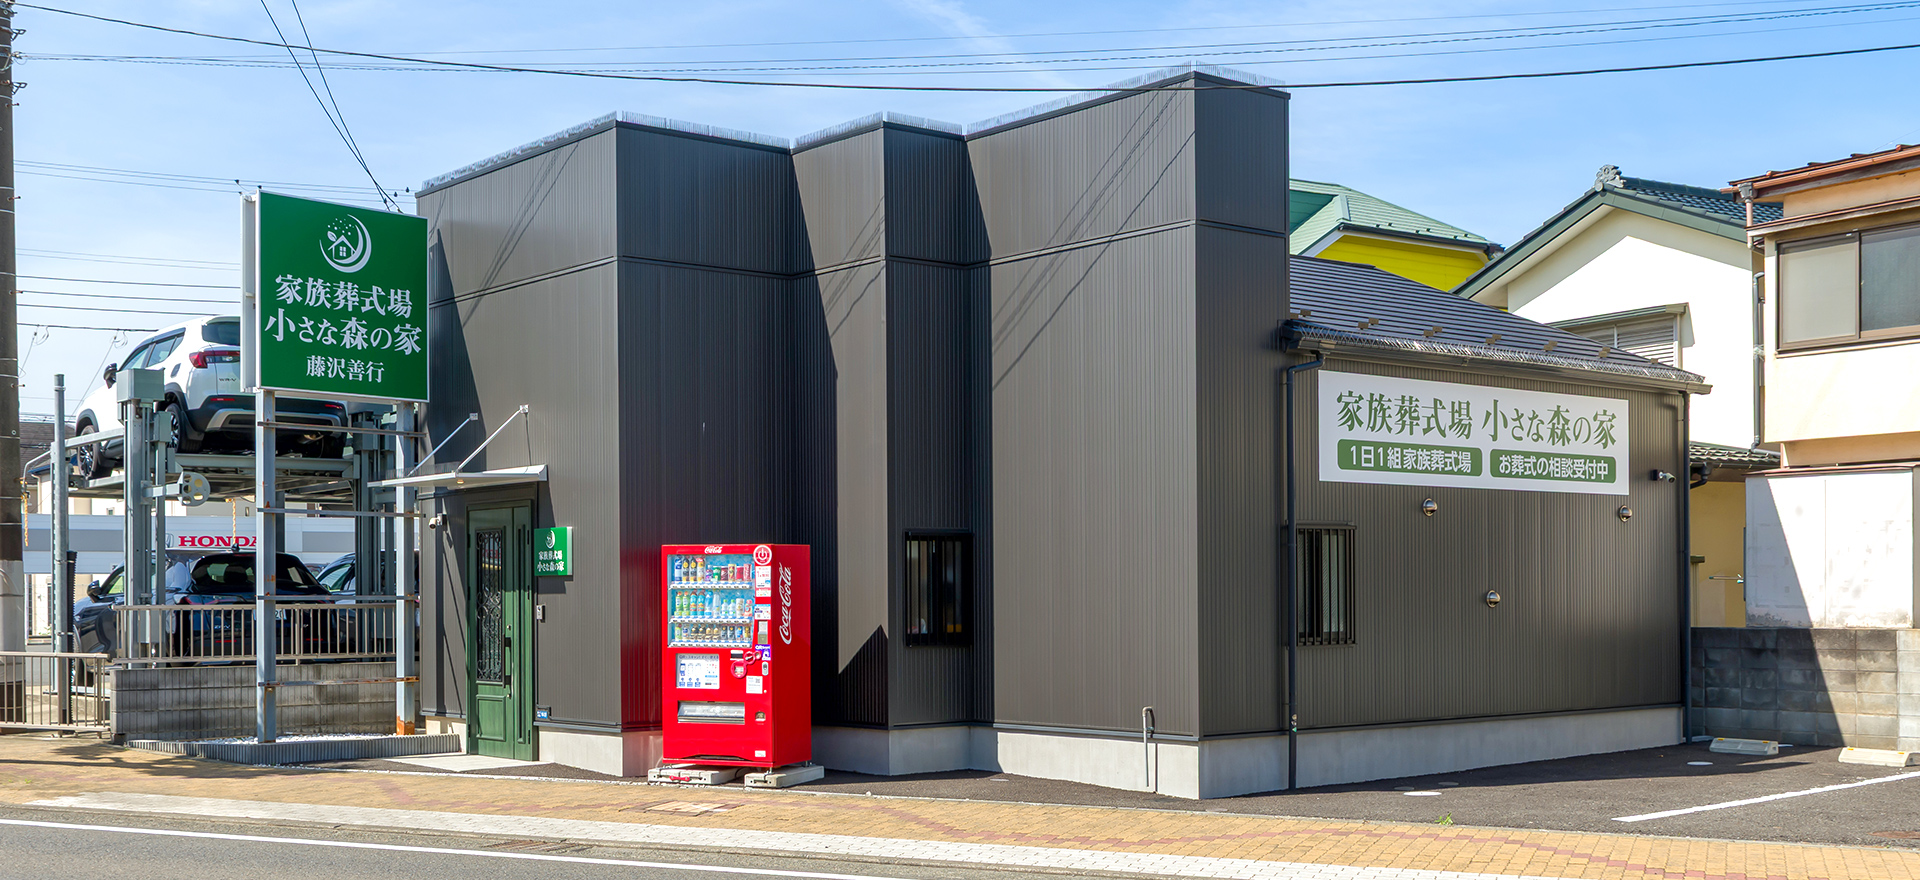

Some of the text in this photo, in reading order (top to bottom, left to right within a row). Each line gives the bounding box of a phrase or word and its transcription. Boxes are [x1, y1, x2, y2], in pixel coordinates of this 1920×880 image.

[275, 273, 413, 319] 家族葬式場
[264, 308, 422, 355] 小さな森の家
[306, 355, 385, 383] 藤沢善行
[1336, 390, 1617, 450] 家族葬式場 小さな森の家
[1350, 445, 1472, 473] 1日1組家族葬式場
[1498, 453, 1609, 480] お葬式の相談受付中
[778, 562, 792, 645] Coca-Cola
